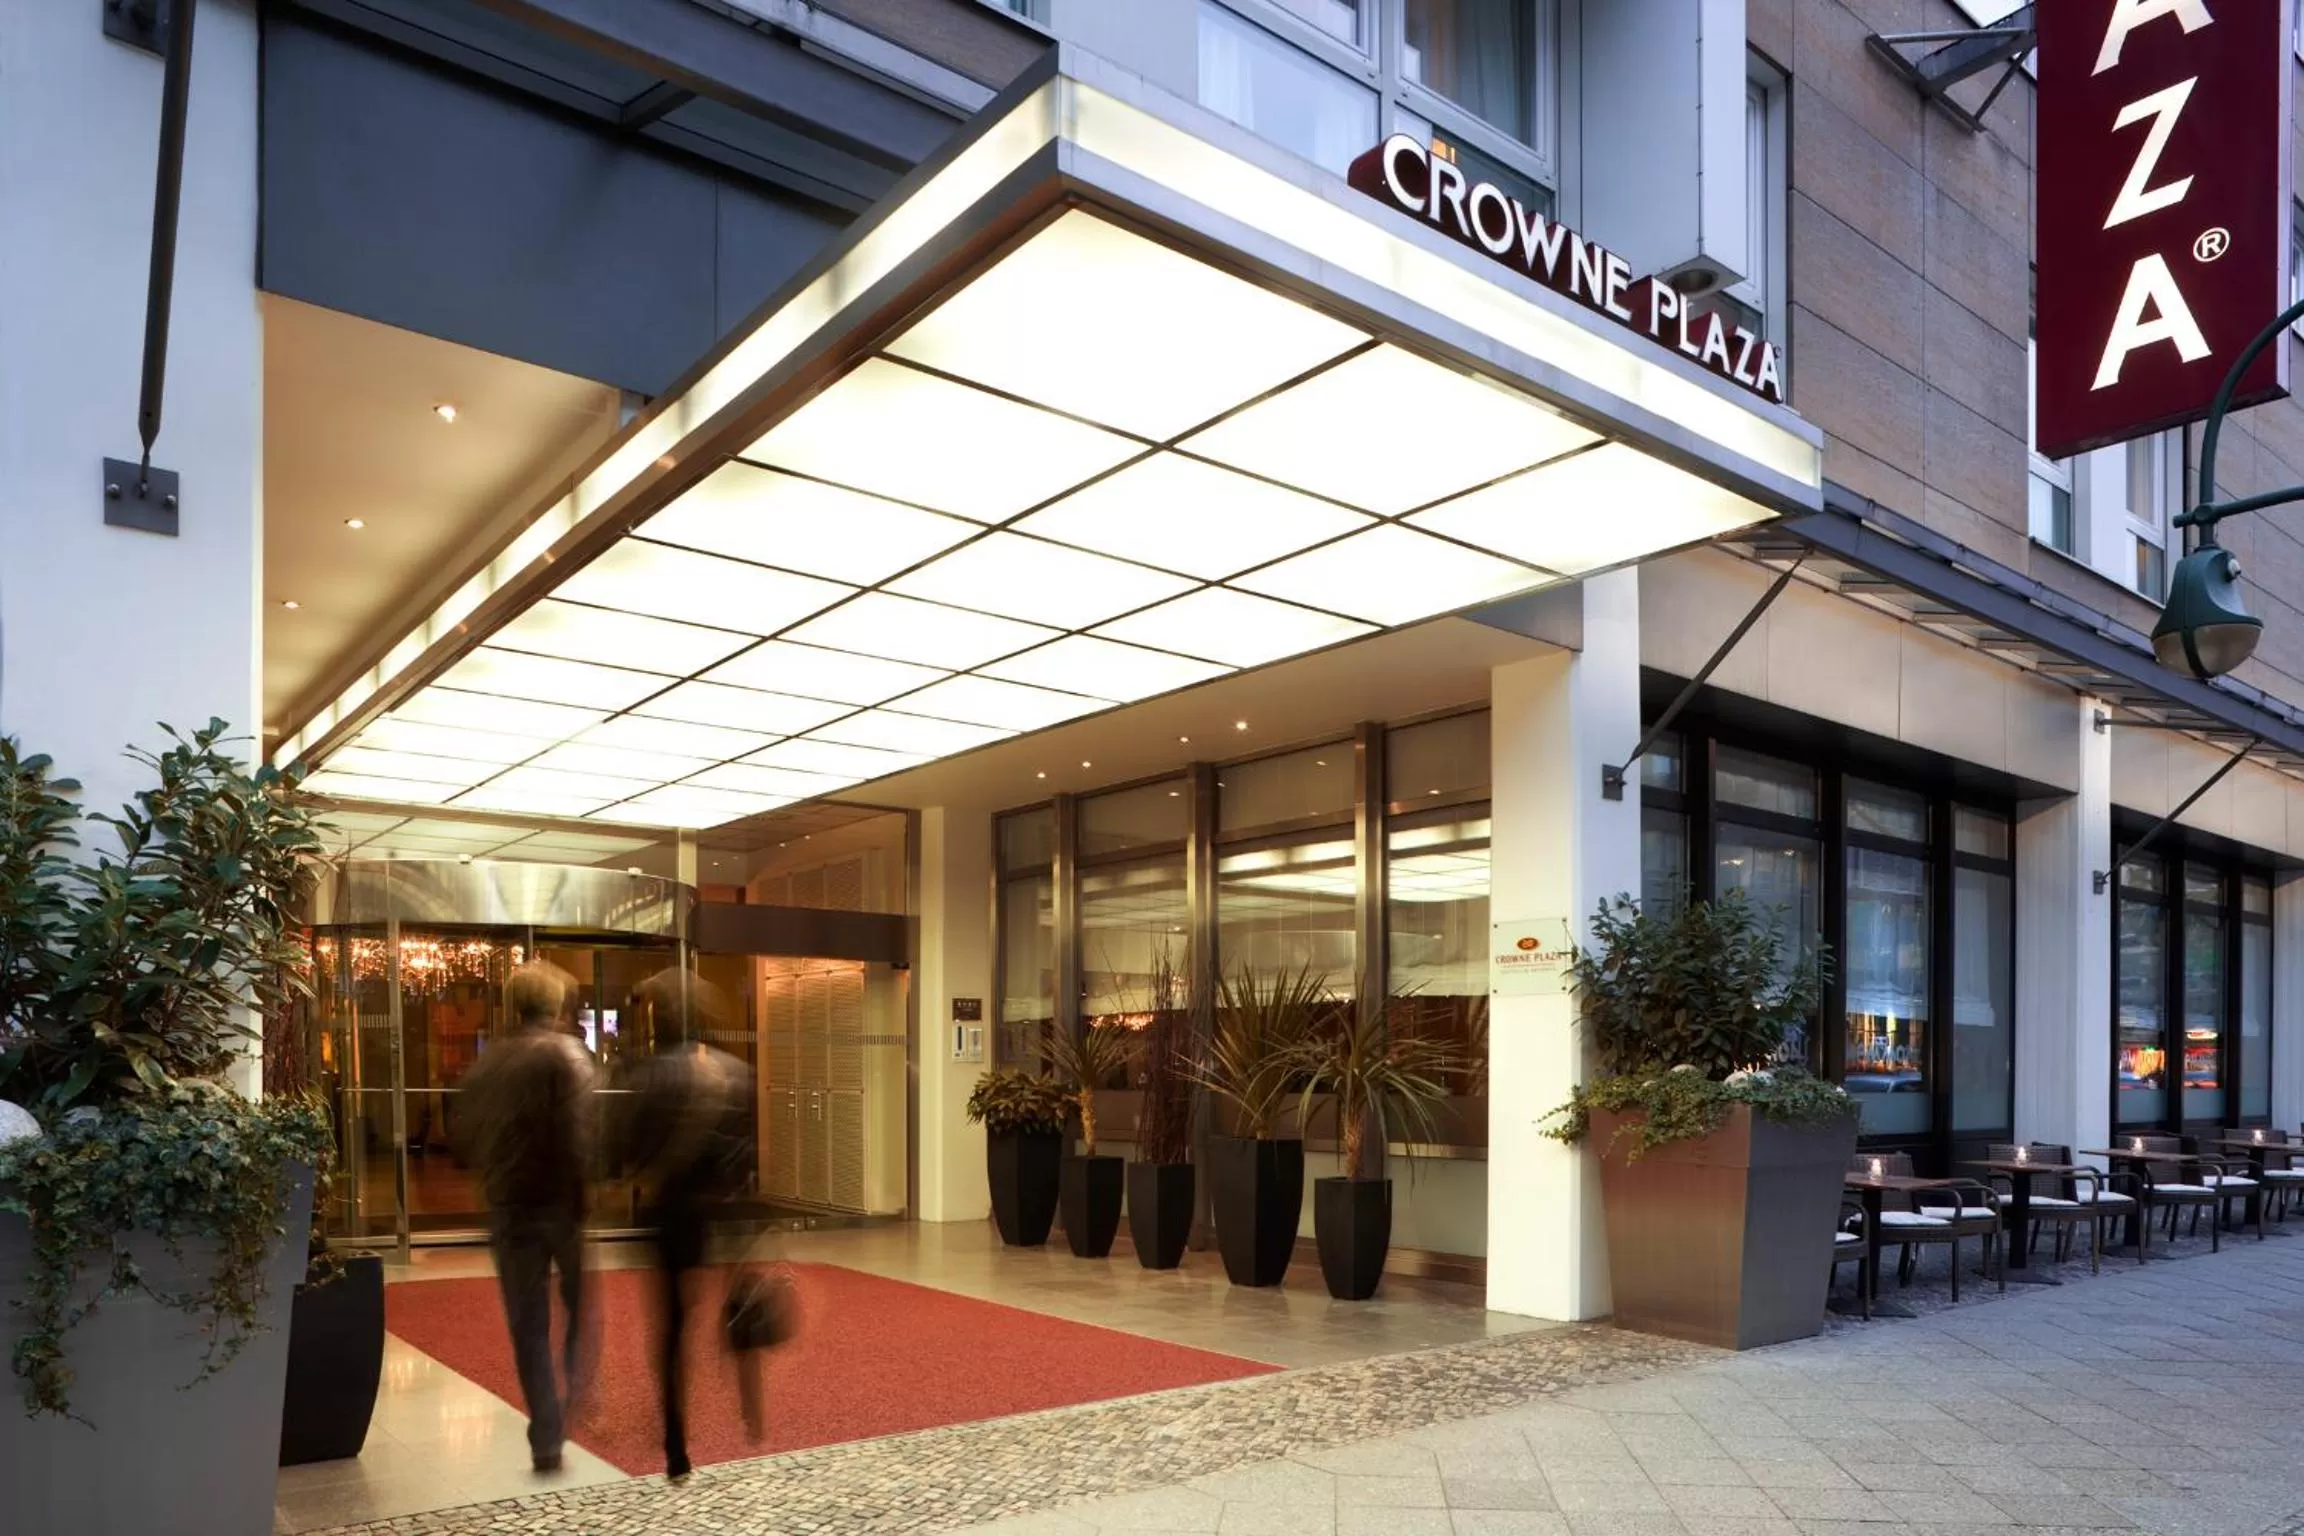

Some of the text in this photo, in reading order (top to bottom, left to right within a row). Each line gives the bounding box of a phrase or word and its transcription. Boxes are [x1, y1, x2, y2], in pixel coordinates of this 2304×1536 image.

[1382, 133, 1782, 401] CROWNE PLAZA
[1495, 951, 1562, 965] CROWNE PLAZA
